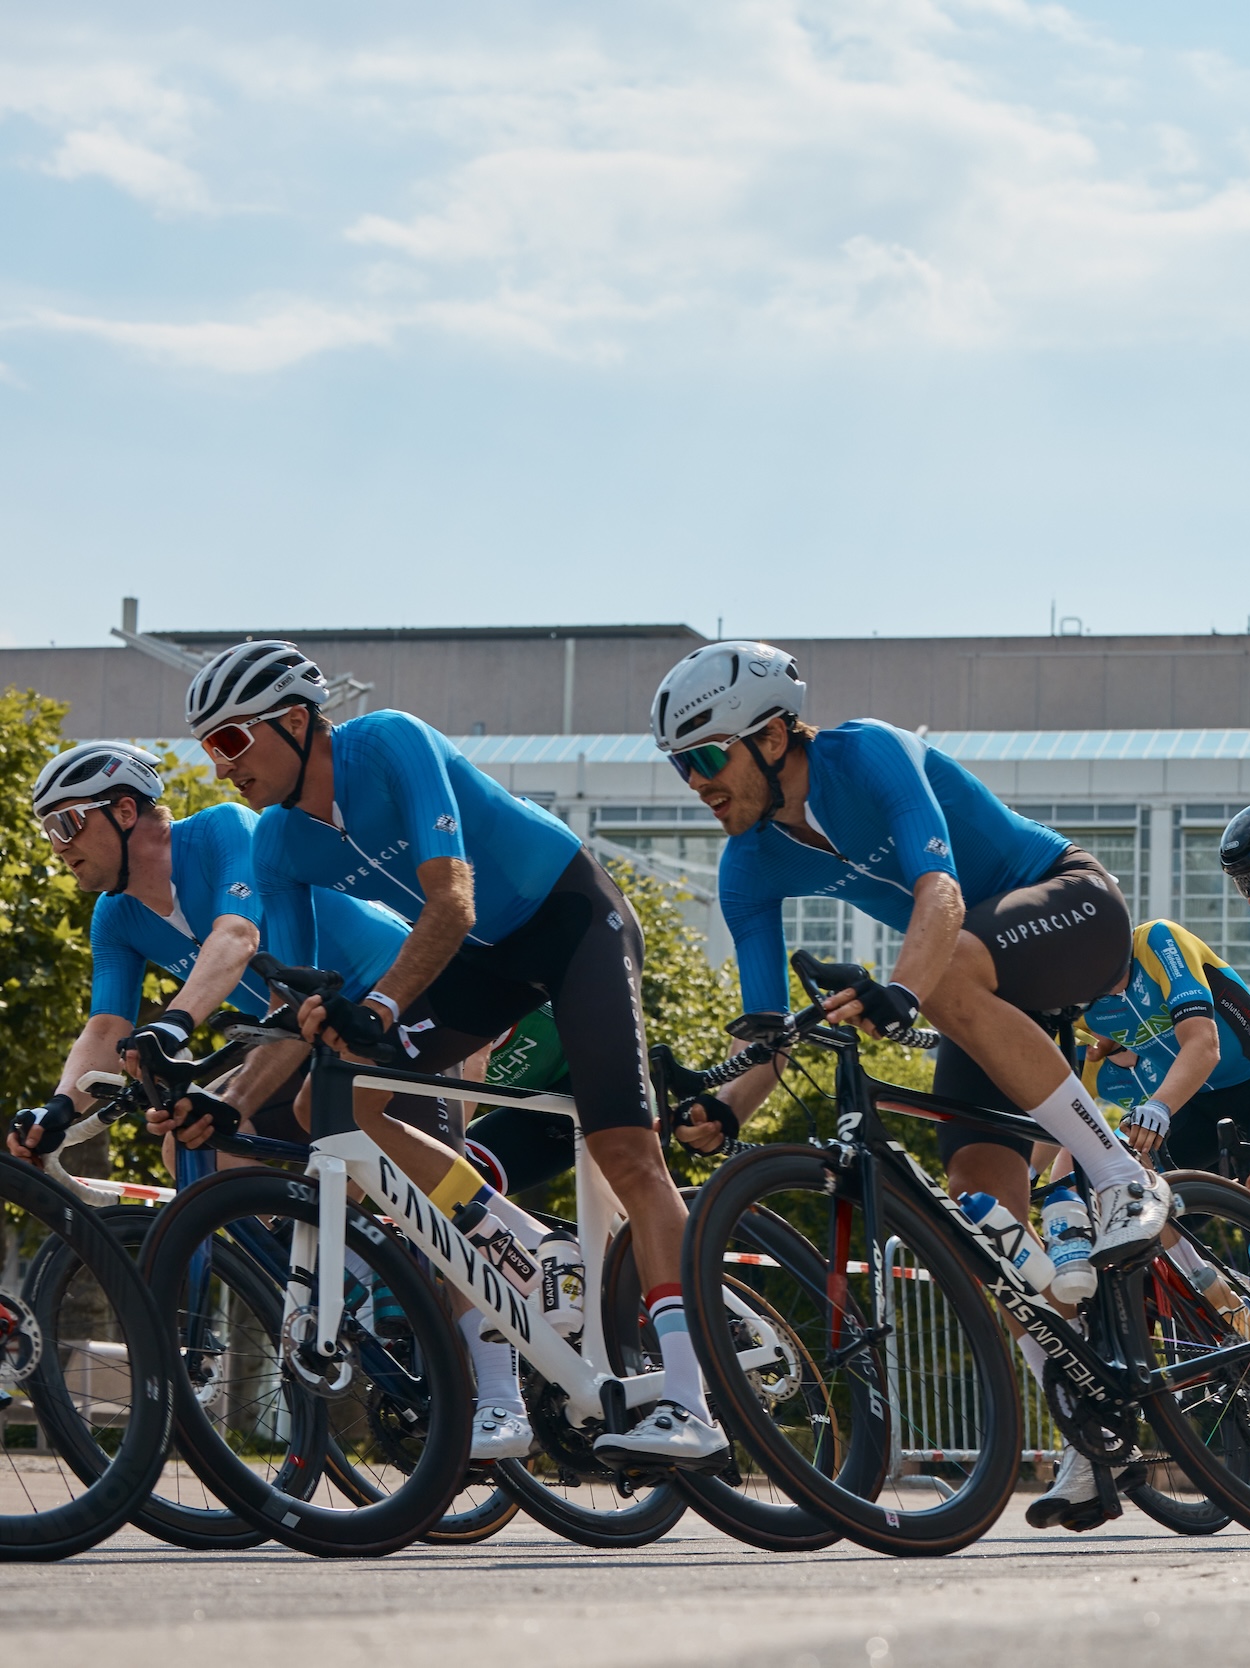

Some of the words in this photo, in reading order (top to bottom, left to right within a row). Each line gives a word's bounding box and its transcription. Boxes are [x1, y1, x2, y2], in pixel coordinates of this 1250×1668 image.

[673, 685, 726, 719] SUPERCIAO
[333, 839, 410, 892] UPERCIA
[996, 901, 1097, 949] SUPERCIAO
[1169, 989, 1203, 1005] vermarc
[1220, 998, 1247, 1027] solutions
[623, 955, 648, 1110] SUPERCIAO
[486, 1036, 537, 1081] UHN
[1073, 1100, 1113, 1149] SUPERCIAO
[350, 1216, 387, 1246] DT
[380, 1155, 531, 1345] CANYON
[987, 1276, 1035, 1323] SLX
[1028, 1320, 1102, 1396] HELIUM
[869, 1381, 885, 1422] DT
